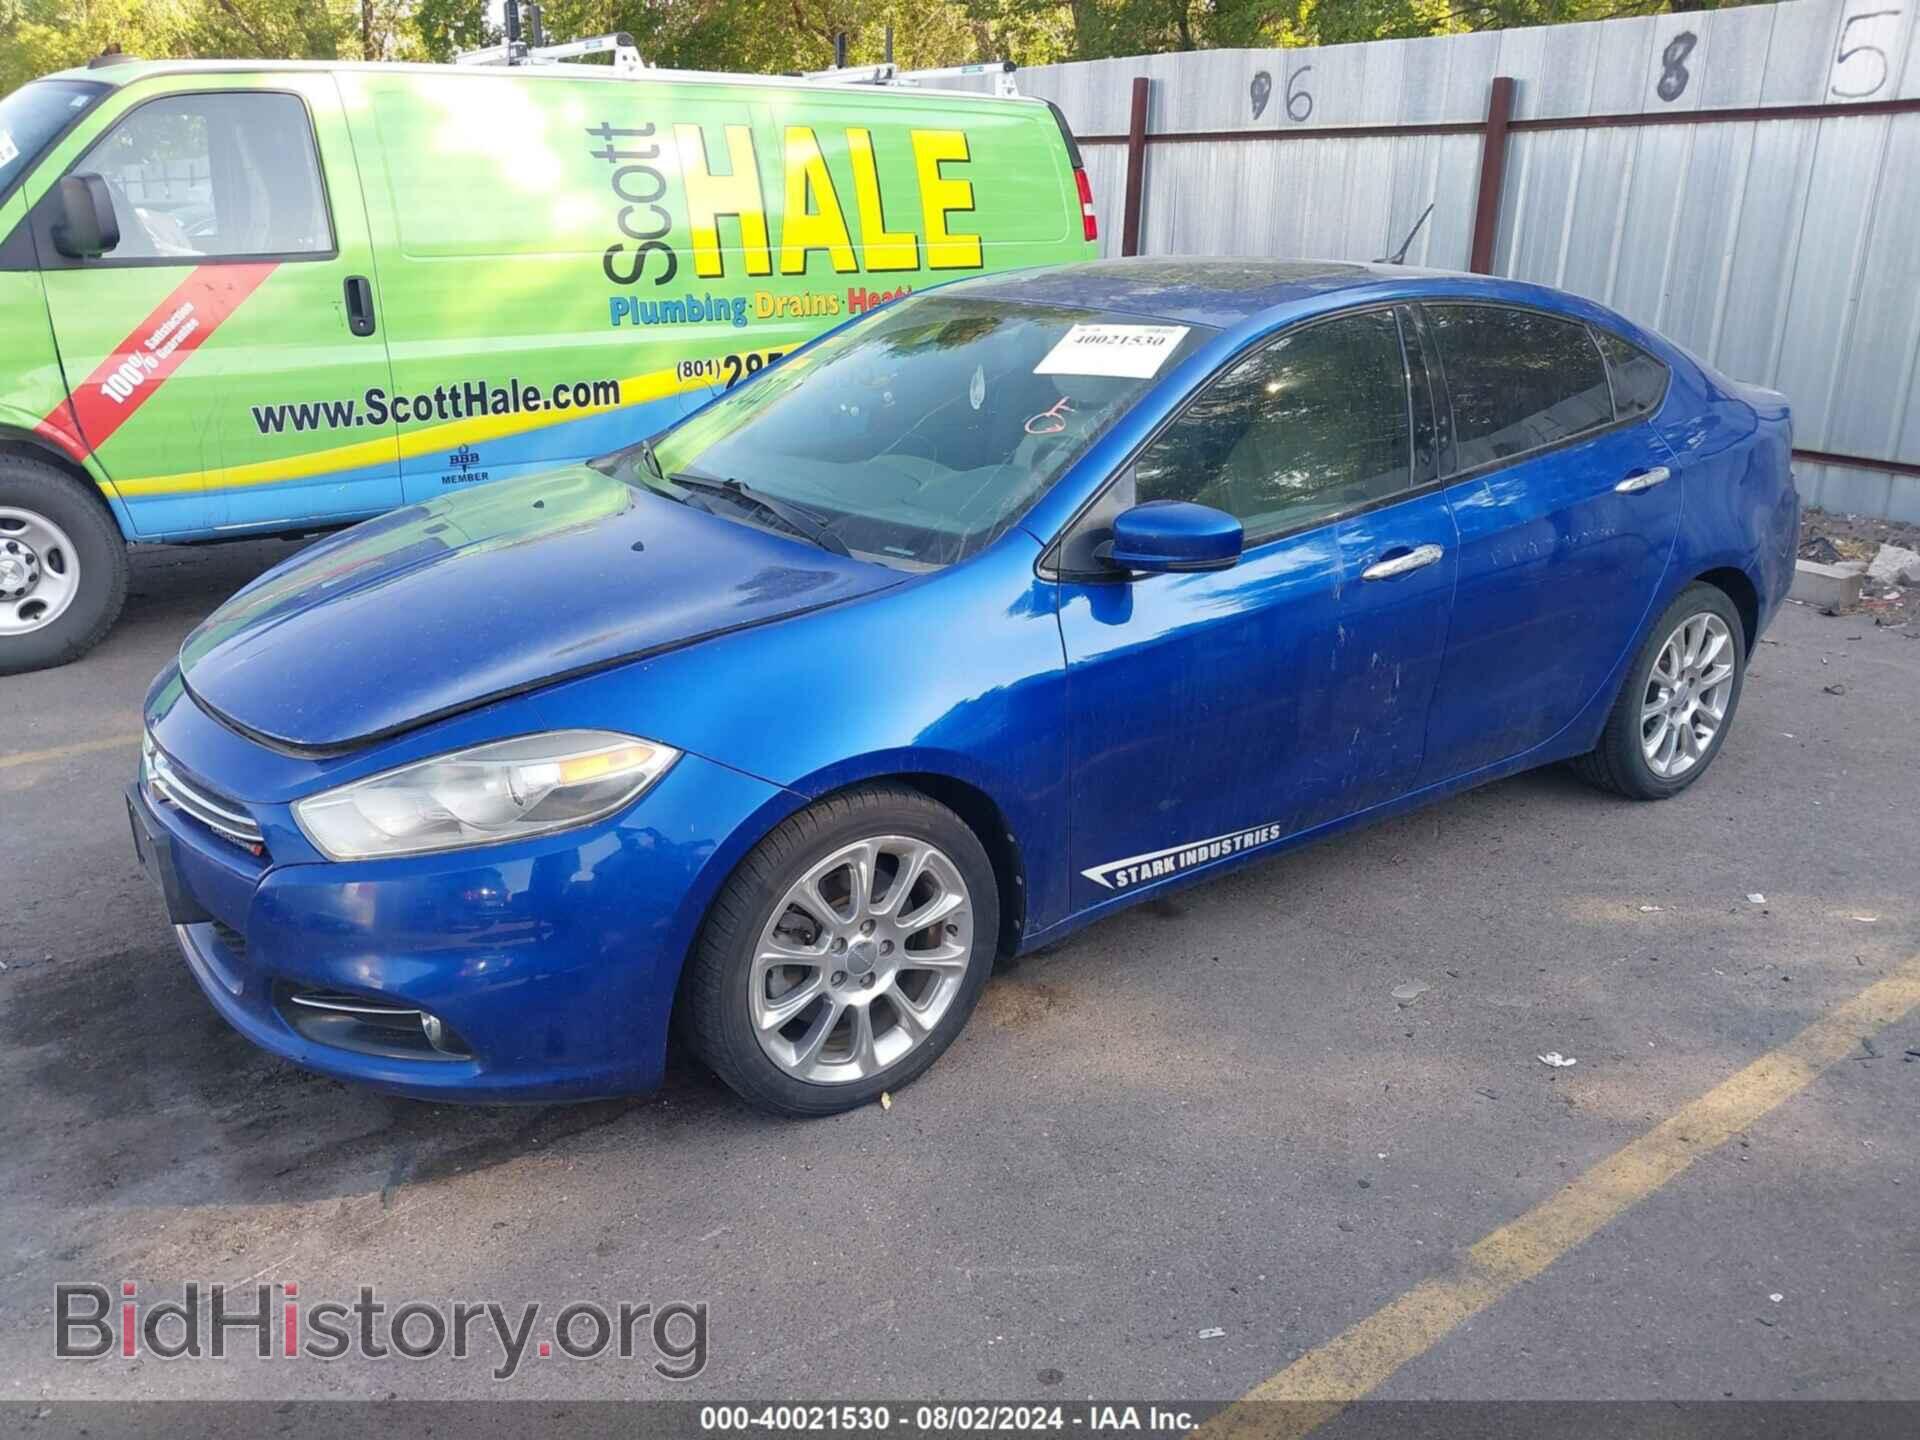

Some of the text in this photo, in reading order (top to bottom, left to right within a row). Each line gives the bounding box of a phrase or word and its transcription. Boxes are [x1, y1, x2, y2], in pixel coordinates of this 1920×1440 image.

[1657, 30, 1698, 102] 8
[1831, 10, 1902, 97] 5
[584, 122, 678, 286] Scott
[672, 123, 984, 278] HALE
[609, 292, 748, 328] Plumbing
[754, 289, 840, 319] Drains
[1074, 335, 1166, 347] 40021530
[100, 350, 159, 404] 100%
[677, 359, 721, 382] (801)
[252, 378, 621, 434] www.ScottHale.com
[441, 472, 489, 485] MEMBER
[448, 453, 480, 465] BBB
[1115, 824, 1281, 888] STARK INDUSTRIES
